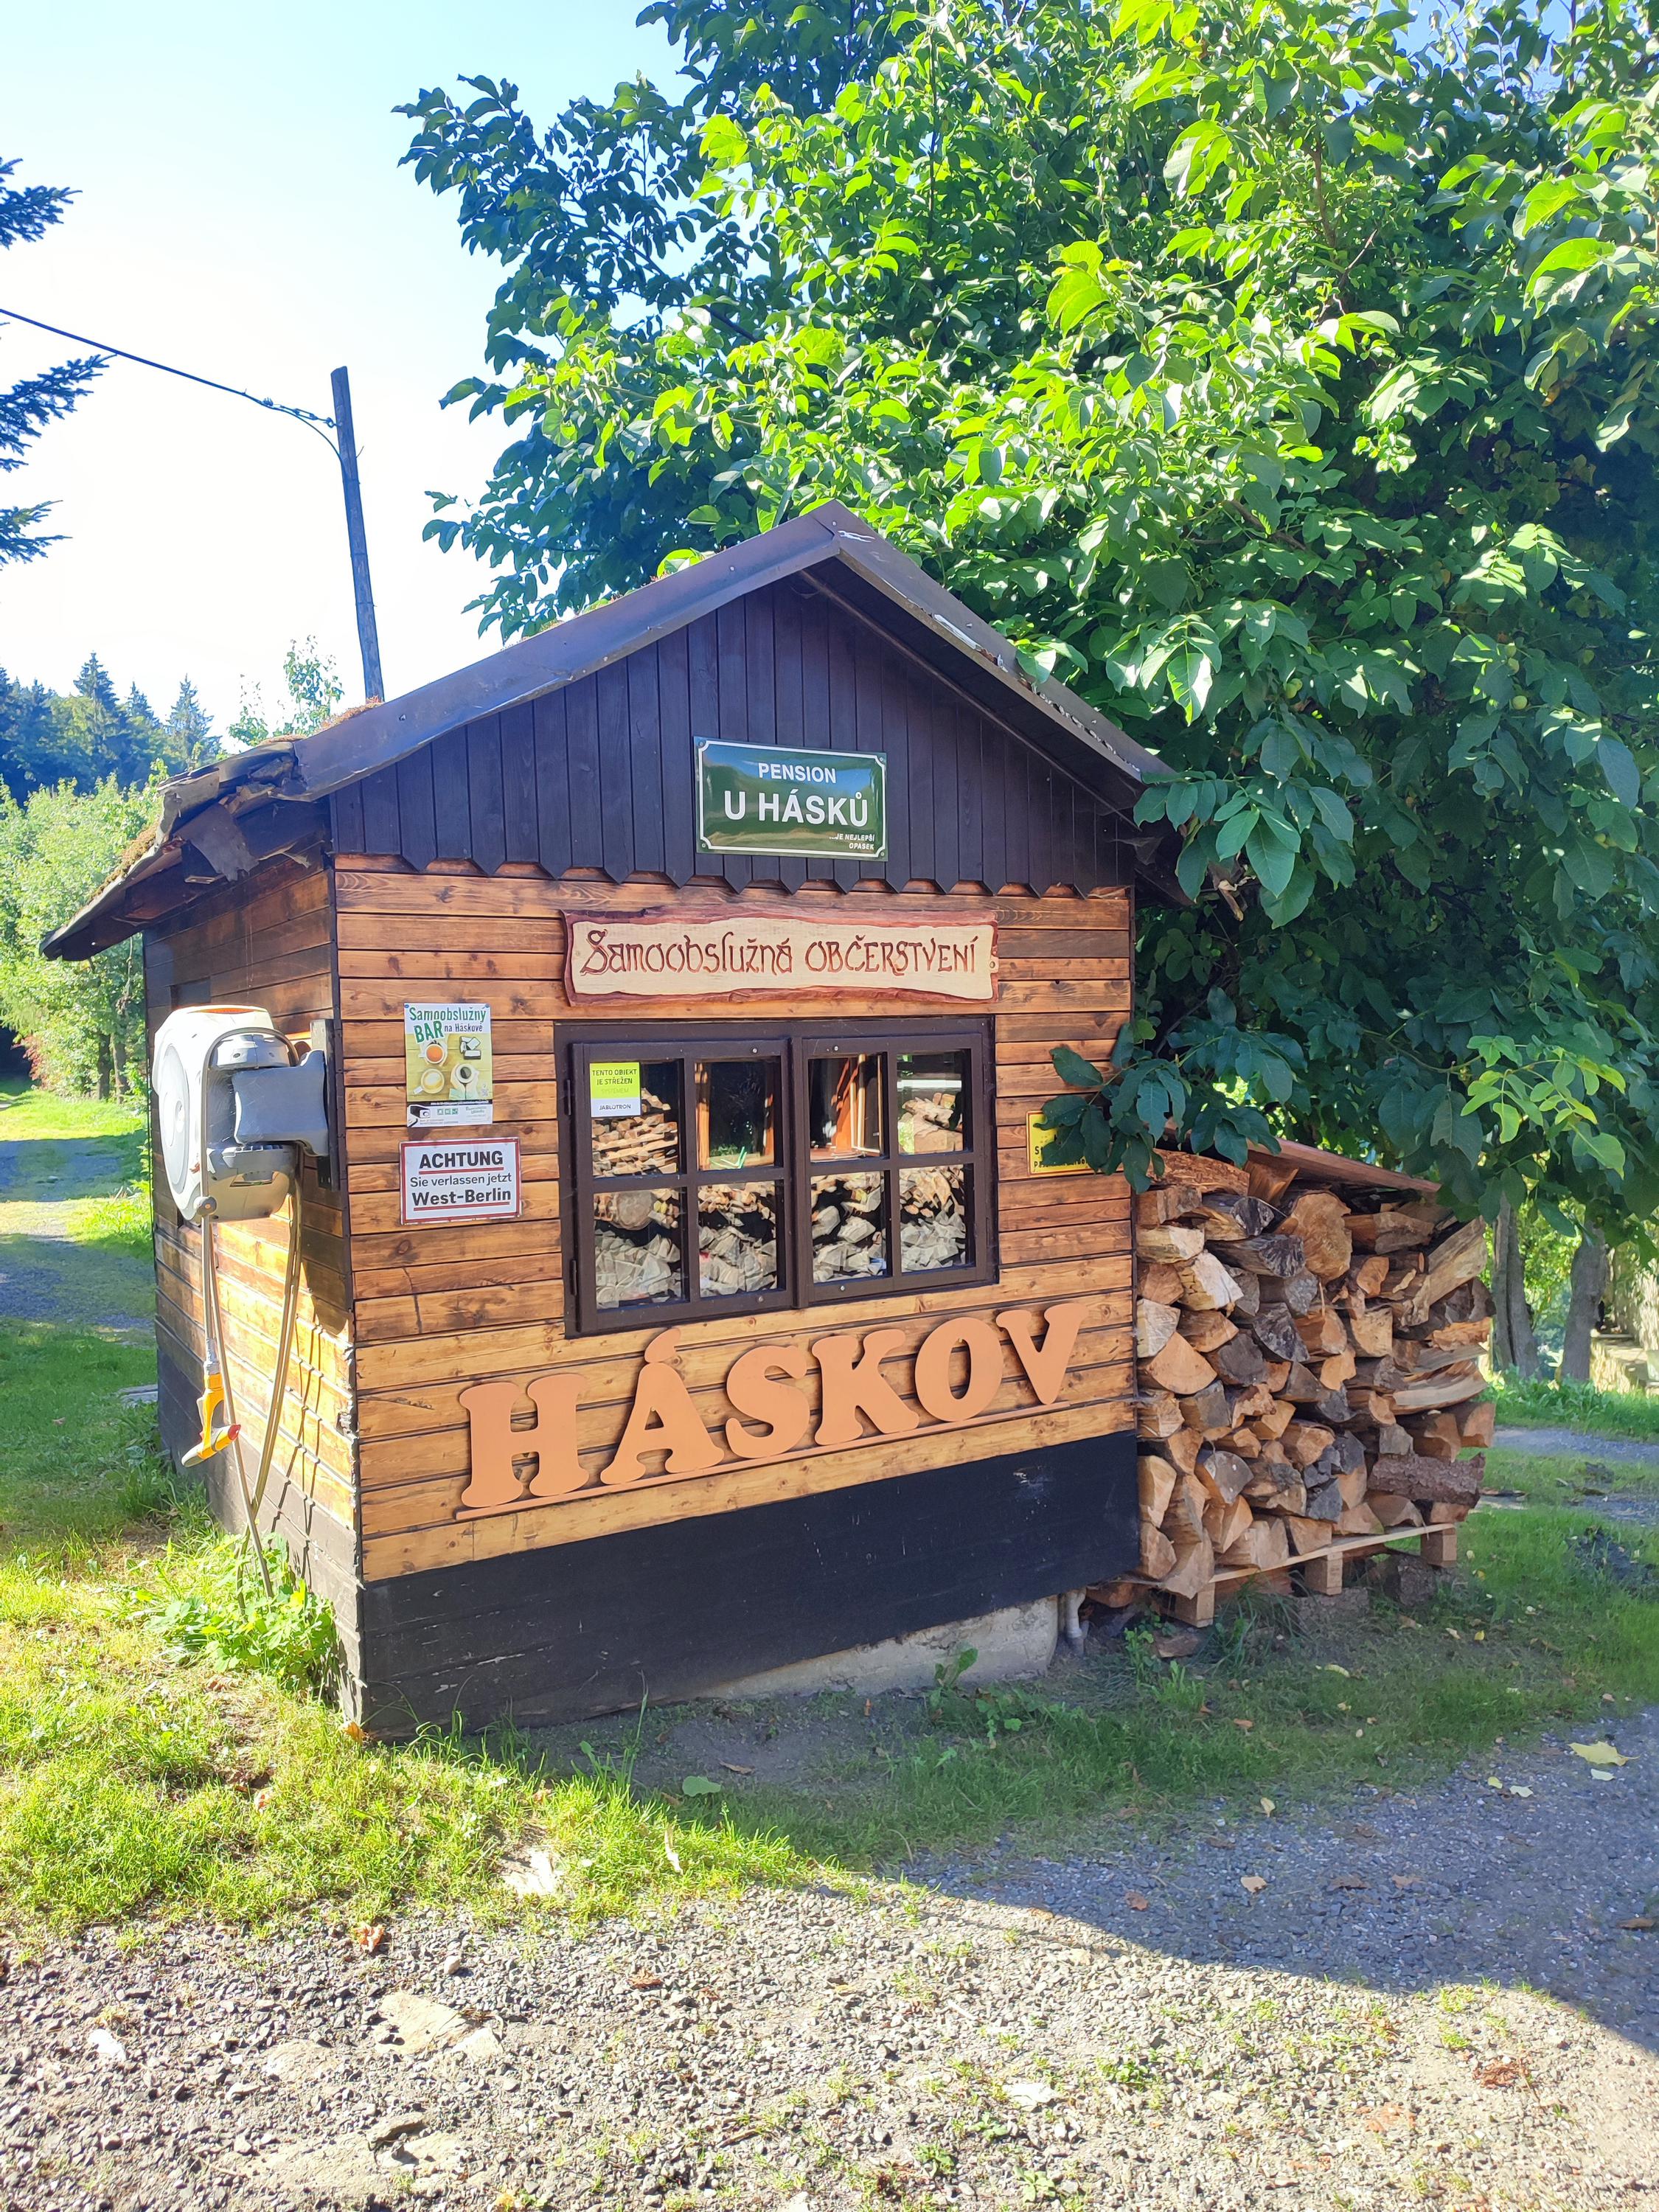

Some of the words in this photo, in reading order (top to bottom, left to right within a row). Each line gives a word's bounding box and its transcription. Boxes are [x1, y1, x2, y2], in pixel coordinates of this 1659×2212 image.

[758, 762, 836, 783] PENSION
[724, 790, 745, 820] U
[759, 788, 868, 827] HÁSKŮ
[849, 842, 874, 850] OPASEK
[804, 935, 978, 976] OBČERSTVENÍ
[409, 1006, 487, 1023] Samoobslužný
[414, 1020, 444, 1043] BAR
[605, 1077, 633, 1085] STŘEŽEN
[419, 1151, 503, 1169] ACHTUNG
[410, 1177, 428, 1187] Sie
[431, 1175, 484, 1186] verlassen
[486, 1172, 512, 1186] jetzt
[412, 1188, 511, 1206] West-Berlin
[459, 1302, 1090, 1508] HÁSKOV
